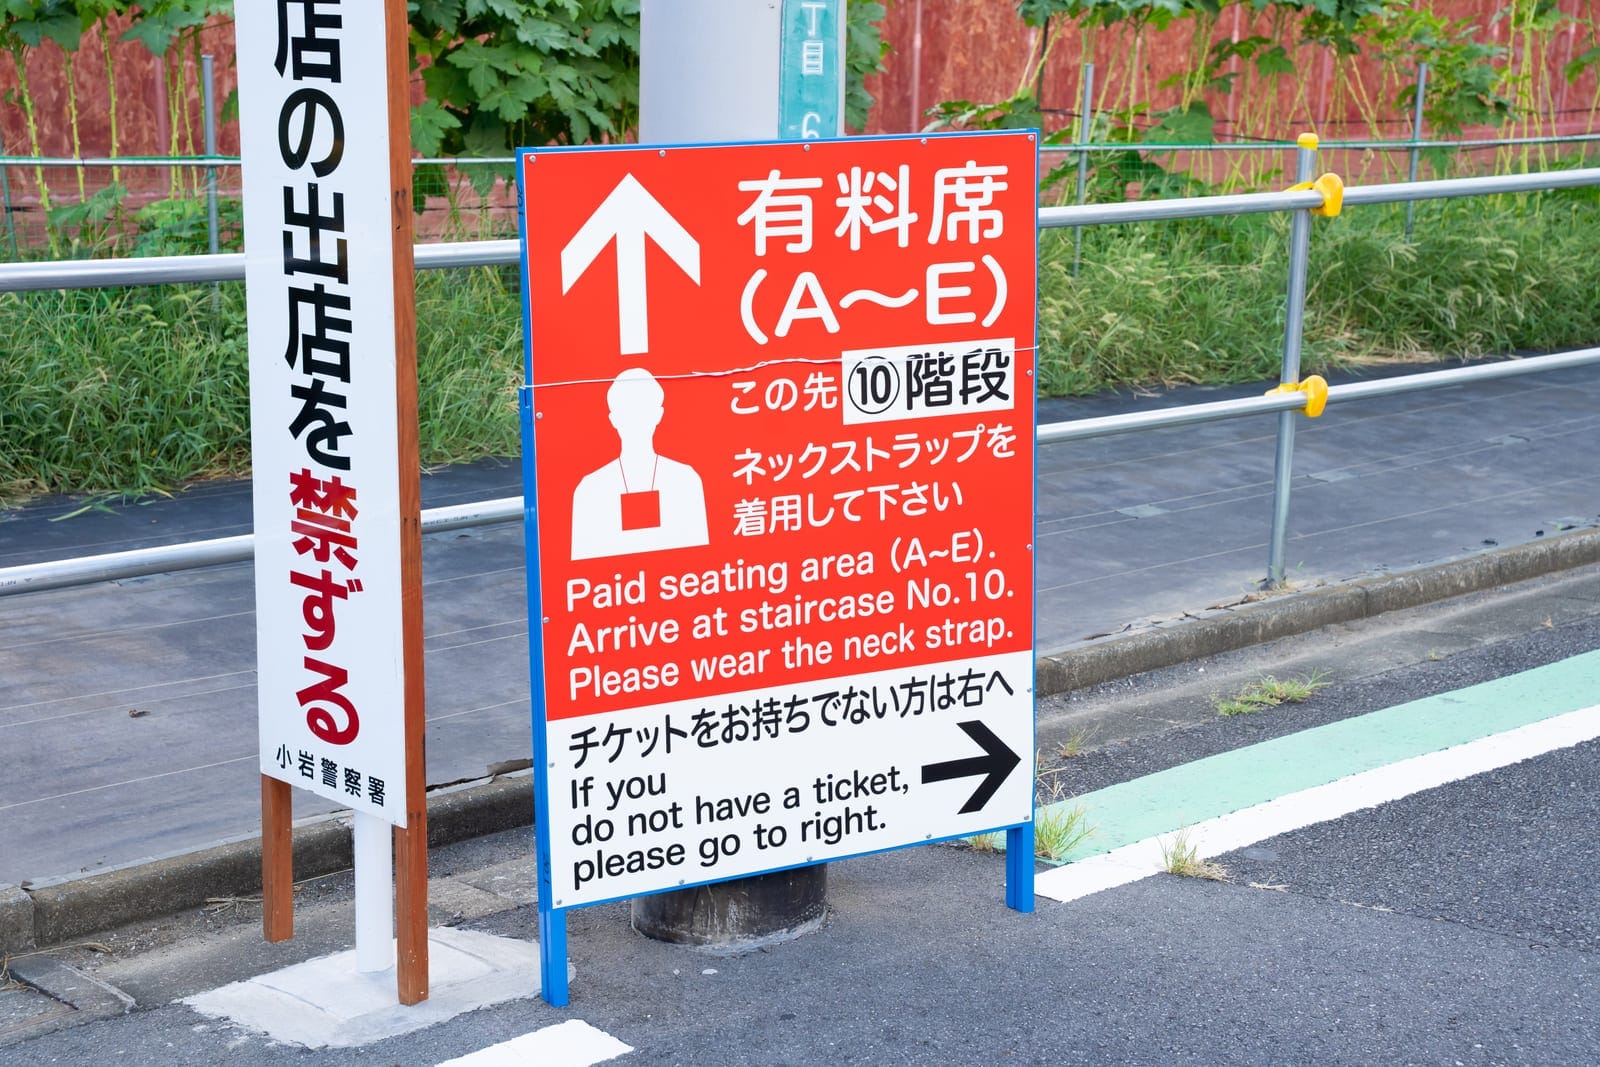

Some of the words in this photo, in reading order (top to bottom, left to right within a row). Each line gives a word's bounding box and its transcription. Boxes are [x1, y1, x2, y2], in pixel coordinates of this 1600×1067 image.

[736, 160, 1009, 257] 有料席
[732, 423, 1017, 486] ネックストラップを
[733, 481, 963, 537] 着用して下さい
[566, 570, 646, 612] Paid
[659, 558, 788, 600] seating
[800, 551, 874, 583] area
[567, 616, 680, 657] Arrive
[692, 607, 728, 640] at
[740, 590, 895, 633] staircase
[907, 568, 1014, 610] No.10.
[569, 662, 679, 701] Please
[690, 648, 771, 682] wear
[781, 638, 833, 669] the
[844, 622, 915, 661] neck
[925, 616, 1013, 649] strap.
[569, 668, 1014, 769] チケットをお持ちでない方は右へ
[276, 743, 386, 807] 小岩警察署
[571, 776, 594, 809] If
[606, 772, 666, 811] you
[572, 815, 614, 846] do
[628, 802, 684, 837] not
[695, 792, 771, 825] have
[783, 787, 800, 810] a
[812, 766, 909, 804] ticket,
[573, 843, 686, 891] please
[698, 833, 741, 867] go
[753, 823, 787, 850] to
[801, 805, 886, 845] right.
